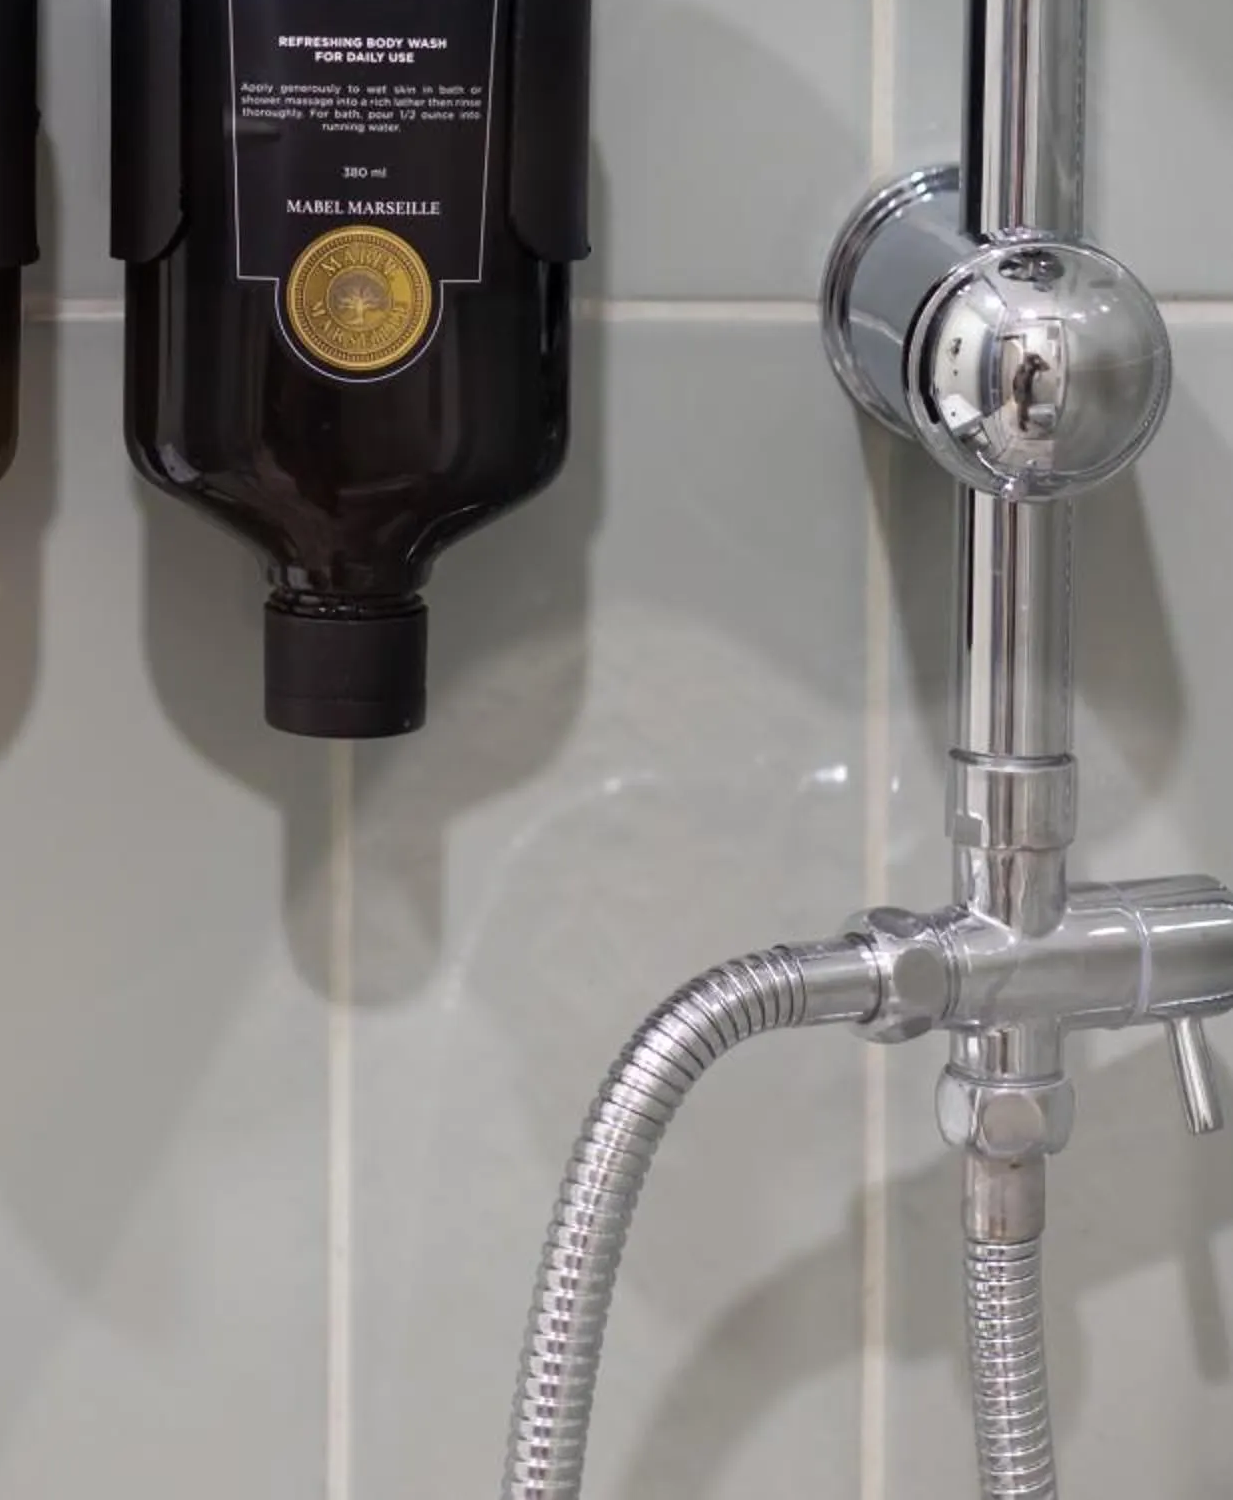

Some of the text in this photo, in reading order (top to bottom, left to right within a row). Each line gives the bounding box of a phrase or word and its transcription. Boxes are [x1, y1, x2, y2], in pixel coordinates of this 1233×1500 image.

[279, 37, 447, 49] REFRESHING BODY WASH
[315, 52, 415, 62] FOR DAILY USE
[241, 83, 483, 94] Apply generously to wet skin in bath or
[241, 96, 281, 104] shower
[285, 97, 333, 108] massage
[337, 97, 357, 106] into
[370, 98, 391, 106] rich
[394, 98, 425, 106] lather
[428, 98, 453, 107] then
[455, 98, 481, 107] rinse
[310, 109, 328, 118] For
[368, 111, 393, 120] pour
[399, 110, 415, 120] 1/2
[421, 112, 454, 120] ounce
[459, 110, 480, 119] into
[322, 123, 365, 133] running
[342, 168, 387, 178] 380 ml
[287, 199, 441, 216] MABEL MARSEILLE
